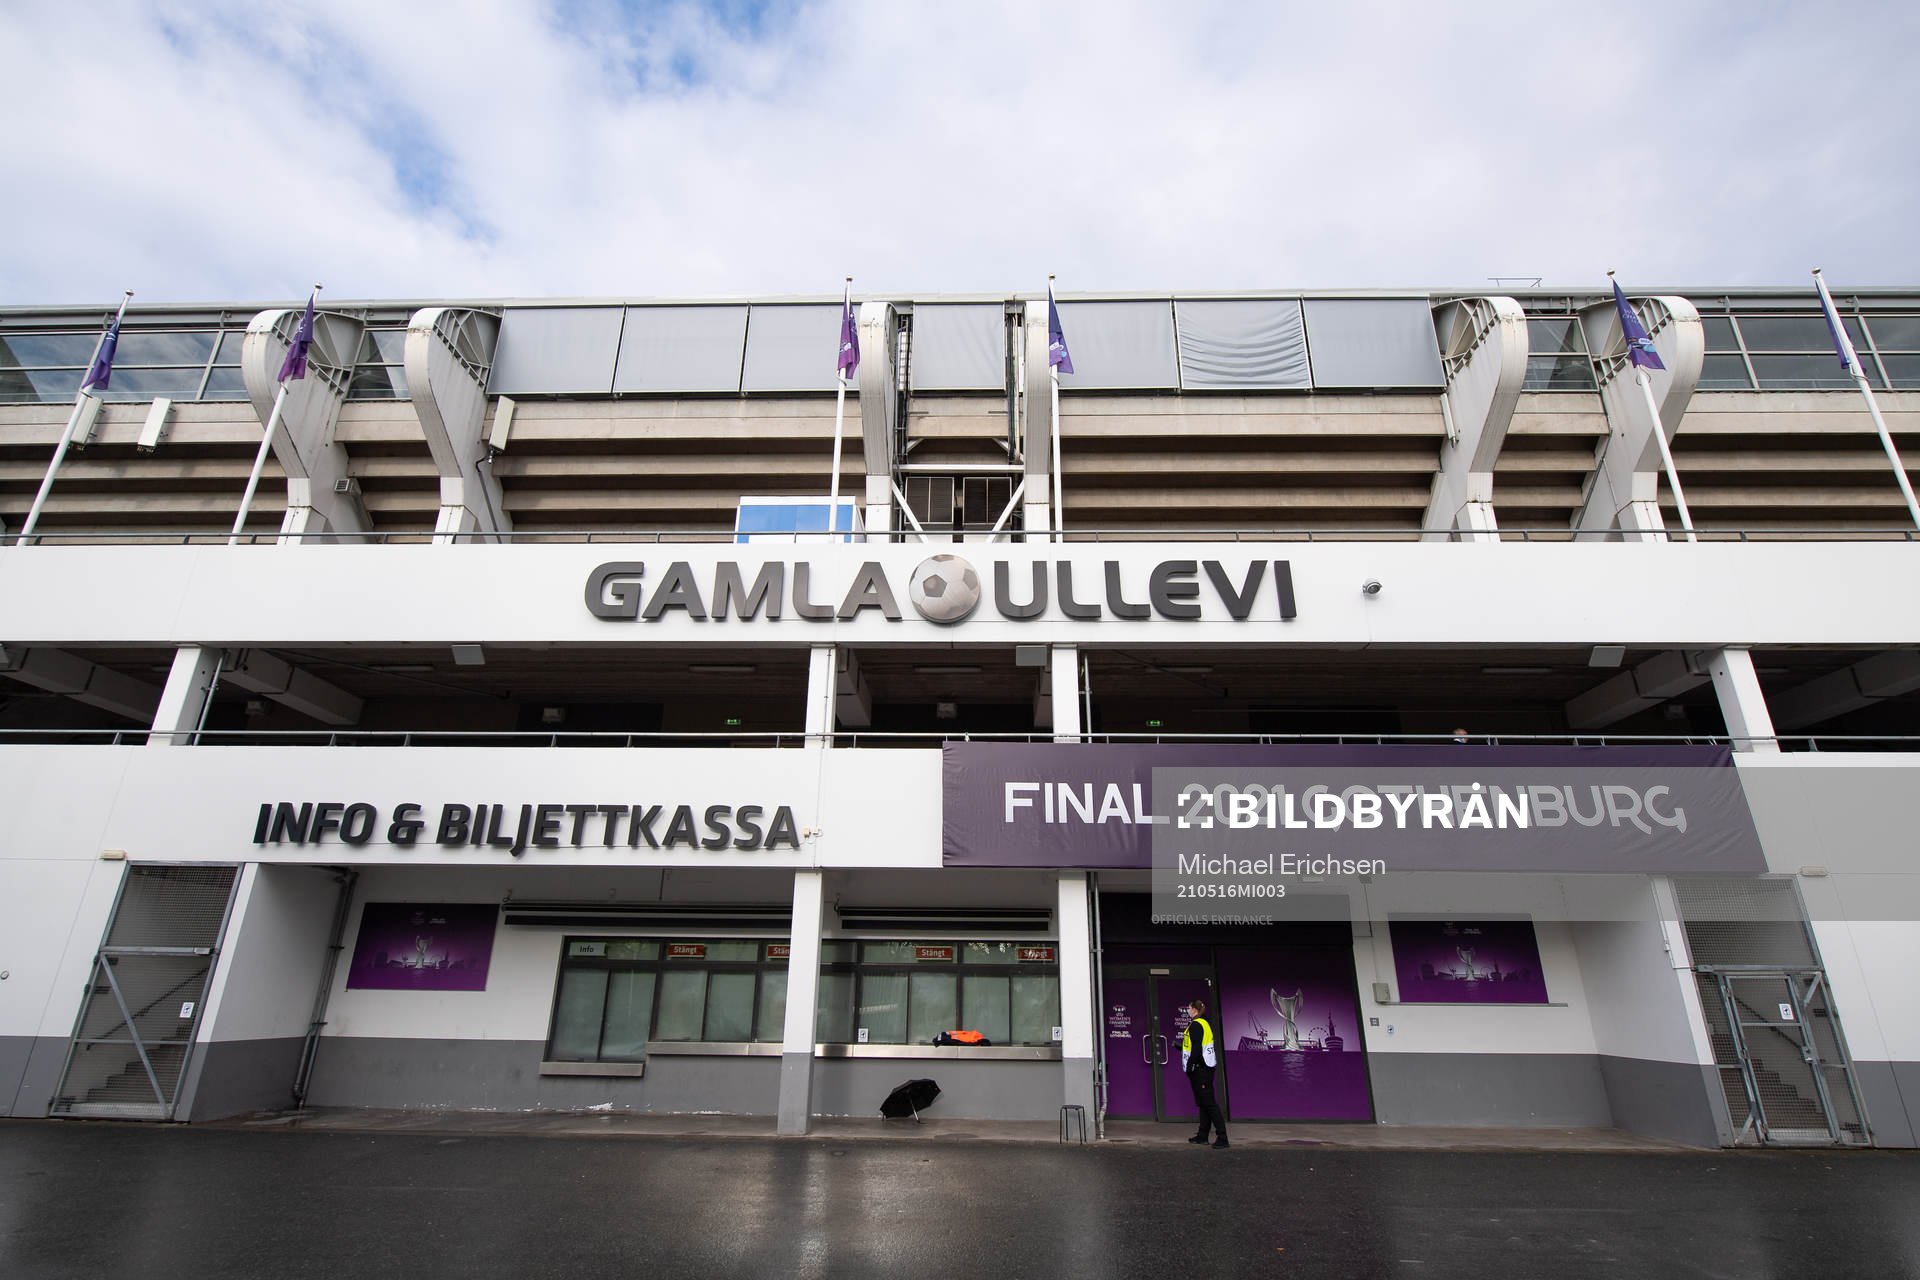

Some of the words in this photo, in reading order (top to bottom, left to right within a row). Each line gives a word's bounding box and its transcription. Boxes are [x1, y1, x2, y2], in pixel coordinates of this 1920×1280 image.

[584, 561, 902, 620] GAMLA
[994, 559, 1297, 619] ULLEVI
[1003, 782, 1170, 825] FINAL
[1182, 783, 1286, 825] 2021
[253, 802, 374, 844] INFO
[388, 803, 424, 844] &
[436, 803, 800, 857] BILJETTKASSA
[1151, 914, 1209, 925] OFFICIALS
[1211, 914, 1274, 926] ENTRANCE
[580, 944, 594, 954] Info
[673, 945, 697, 955] Stängt
[921, 949, 945, 957] Stängt
